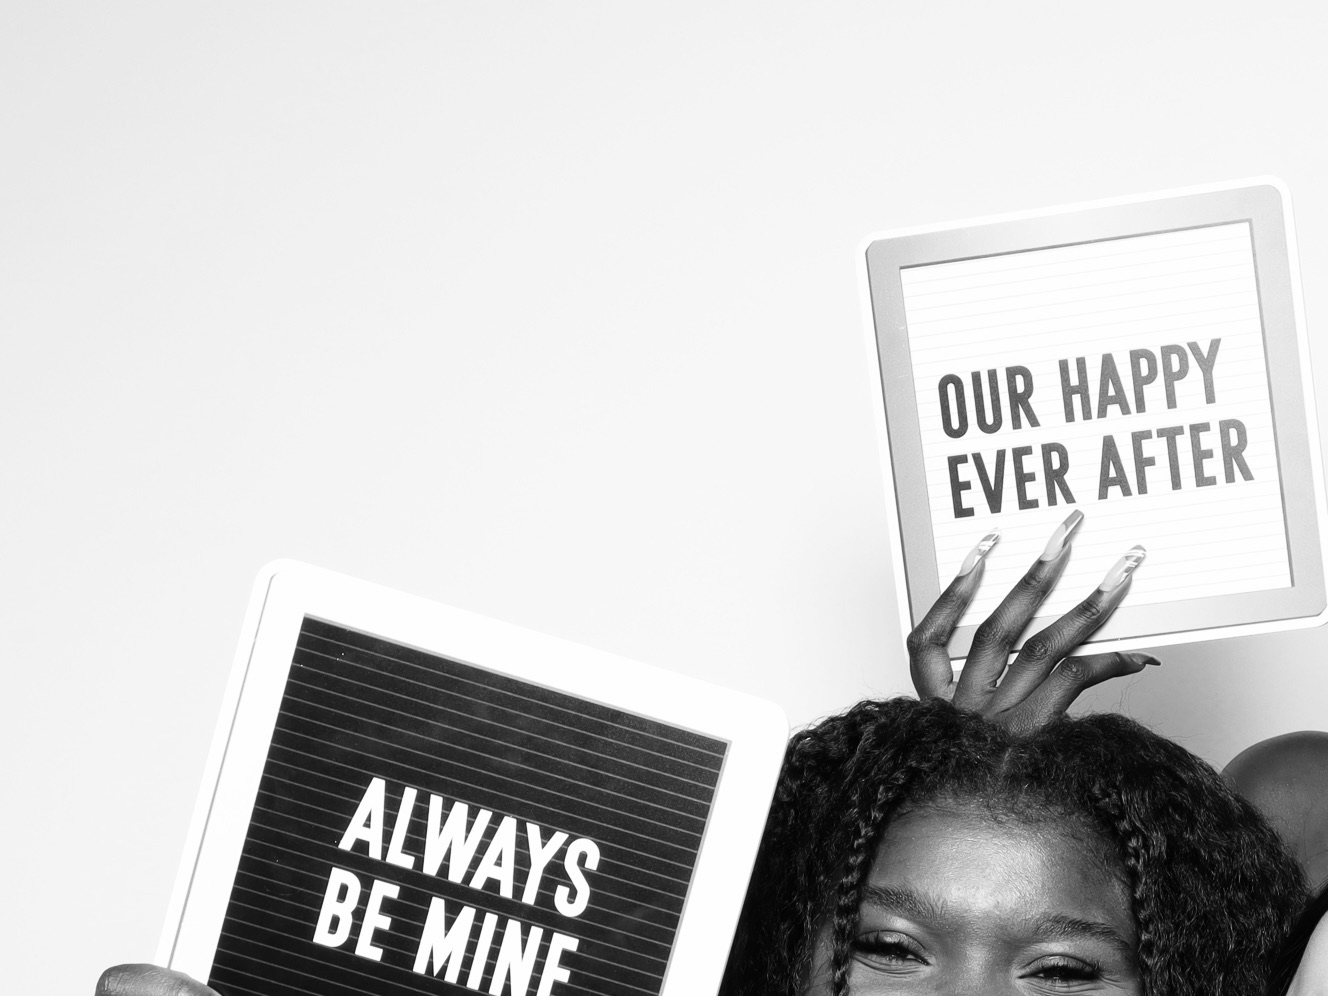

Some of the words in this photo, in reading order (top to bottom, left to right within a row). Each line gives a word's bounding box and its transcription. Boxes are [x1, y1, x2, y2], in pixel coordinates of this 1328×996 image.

[938, 365, 1041, 439] OUR
[1059, 337, 1222, 423] HAPPY
[947, 441, 1076, 519] EVER
[1098, 418, 1255, 500] AFTER
[338, 777, 600, 918] ALWAYS
[313, 867, 400, 961] BE
